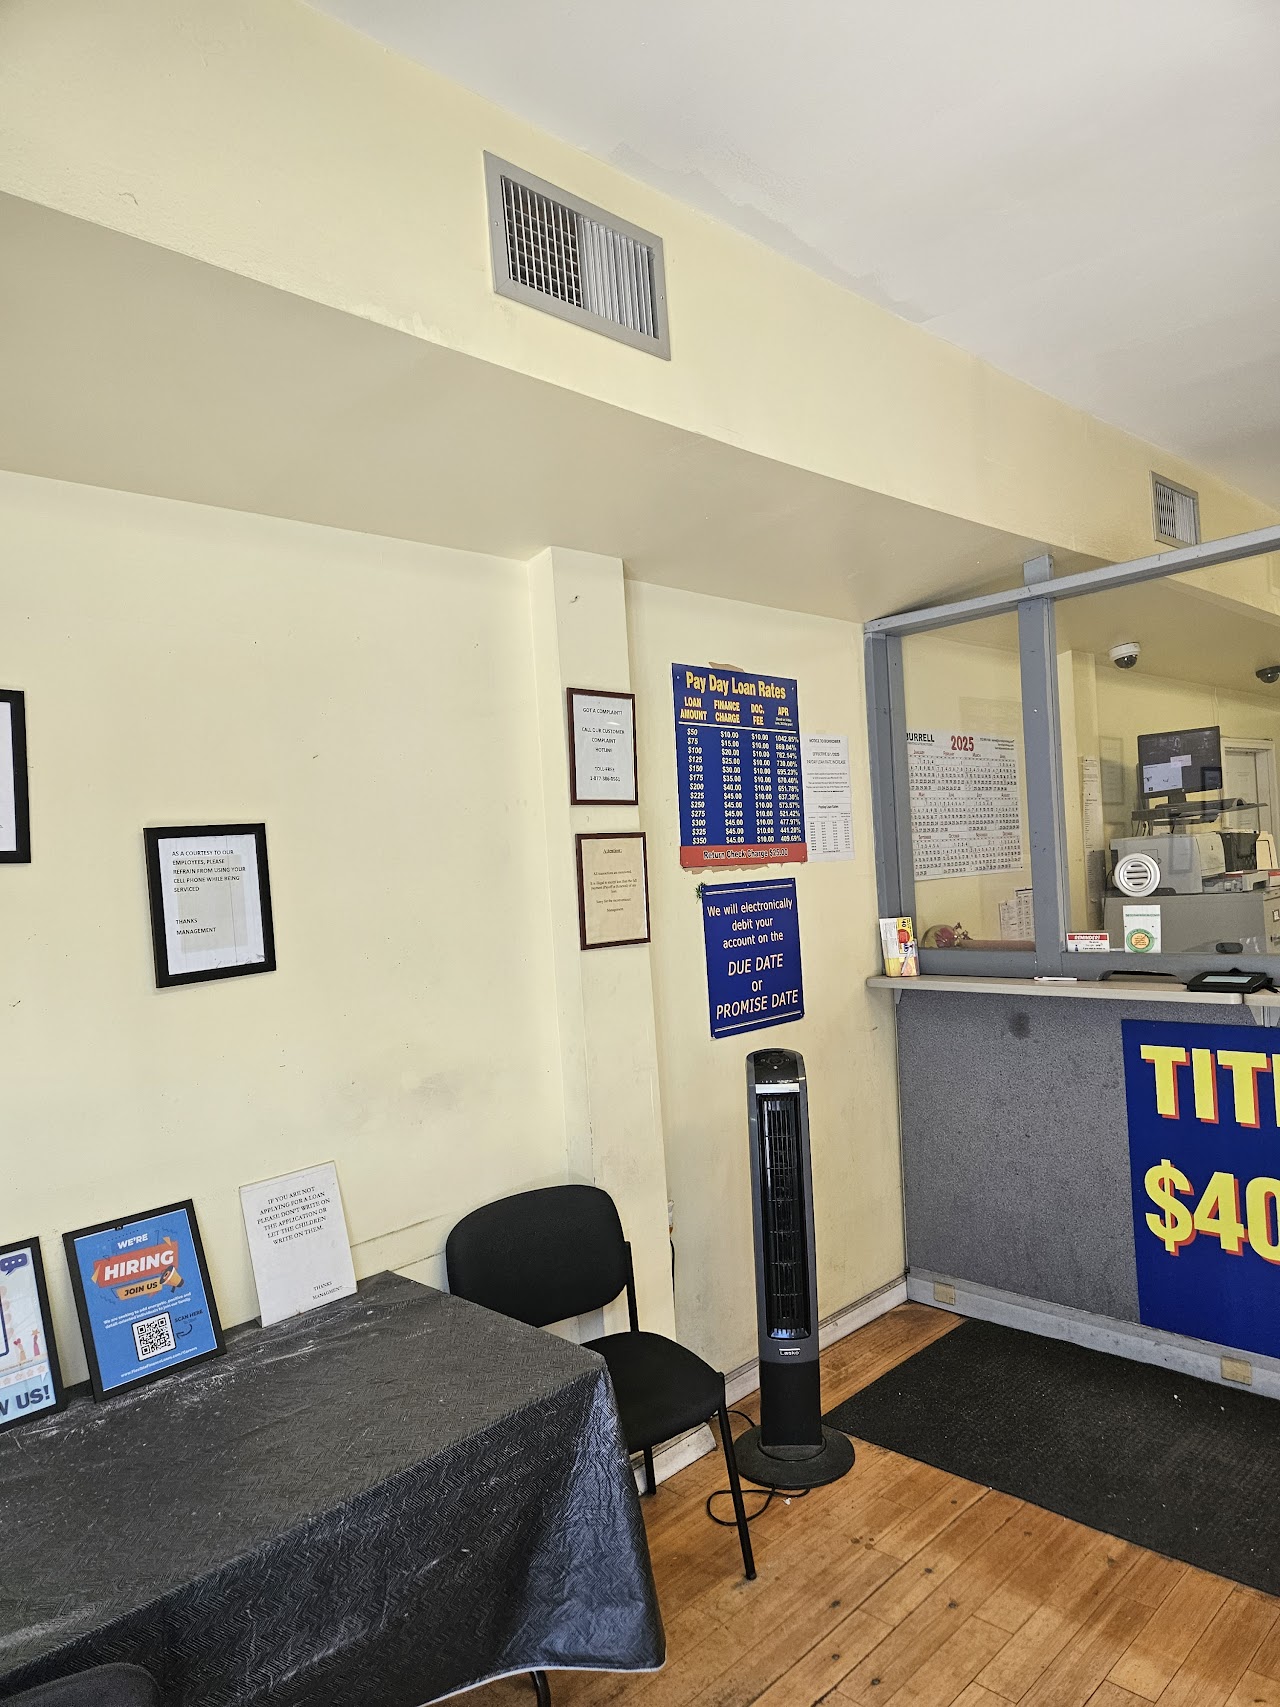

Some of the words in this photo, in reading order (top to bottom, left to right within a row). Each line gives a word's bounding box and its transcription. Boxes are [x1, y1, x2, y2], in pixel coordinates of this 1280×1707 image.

[686, 671, 706, 693] Pay
[709, 674, 729, 696] Day
[732, 677, 756, 696] Loan
[758, 680, 786, 699] Rates
[684, 696, 701, 707] LOAN
[714, 700, 740, 711] FINANCE
[751, 704, 764, 714] DOC.
[778, 707, 789, 717] APR
[680, 709, 707, 721] AMOUNT
[715, 712, 740, 724] CHARGE
[753, 716, 764, 725] FEE
[687, 728, 698, 736] $50
[752, 742, 769, 750] $10.00
[906, 733, 934, 742] URRELL
[951, 735, 974, 751] 2025
[688, 746, 702, 754] $100
[722, 748, 739, 756] $20.00
[722, 757, 740, 765] $25.00
[722, 766, 740, 774] $30.00
[692, 828, 706, 836] $325
[703, 850, 725, 859] Return
[726, 850, 746, 858] Check
[748, 849, 768, 858] Charge
[707, 905, 720, 917] We
[724, 903, 738, 914] will
[740, 898, 793, 913] electronically
[176, 927, 216, 936] MANAGEMENT
[732, 919, 752, 931] debit
[756, 917, 773, 930] your
[723, 936, 755, 949] account
[758, 933, 768, 944] on
[770, 931, 783, 942] the
[728, 958, 751, 976] DUE
[755, 953, 784, 973] DATE
[752, 979, 762, 992] or
[716, 995, 768, 1020] PROMISE
[771, 989, 798, 1007] DATE
[1140, 1044, 1280, 1128] TIT
[274, 1195, 288, 1203] YOU
[289, 1191, 301, 1199] ARE
[302, 1186, 315, 1195] NOT
[256, 1213, 280, 1224] PLEASE
[281, 1208, 300, 1218] DON'T
[301, 1202, 320, 1212] WRITE
[321, 1198, 330, 1206] ON
[260, 1202, 290, 1215] APPLYING
[308, 1191, 325, 1201] LOAN
[264, 1222, 277, 1231] THE
[278, 1210, 318, 1227] APPLICATION
[267, 1230, 279, 1238] LET
[281, 1226, 294, 1235] THE
[295, 1216, 326, 1230] CHILDREN
[117, 1233, 148, 1249] WE'RE
[273, 1235, 293, 1245] WRITE
[294, 1231, 303, 1239] ON
[305, 1226, 323, 1236] THEM.
[104, 1250, 174, 1282] HIRING
[124, 1285, 145, 1297] JOIN
[147, 1282, 158, 1291] US
[312, 1286, 342, 1300] MANAGMENT
[314, 1281, 332, 1291] THANKS
[168, 1296, 183, 1304] positive
[175, 1314, 188, 1322] SCAN
[190, 1309, 203, 1318] HERE
[16, 1385, 50, 1409] US!
